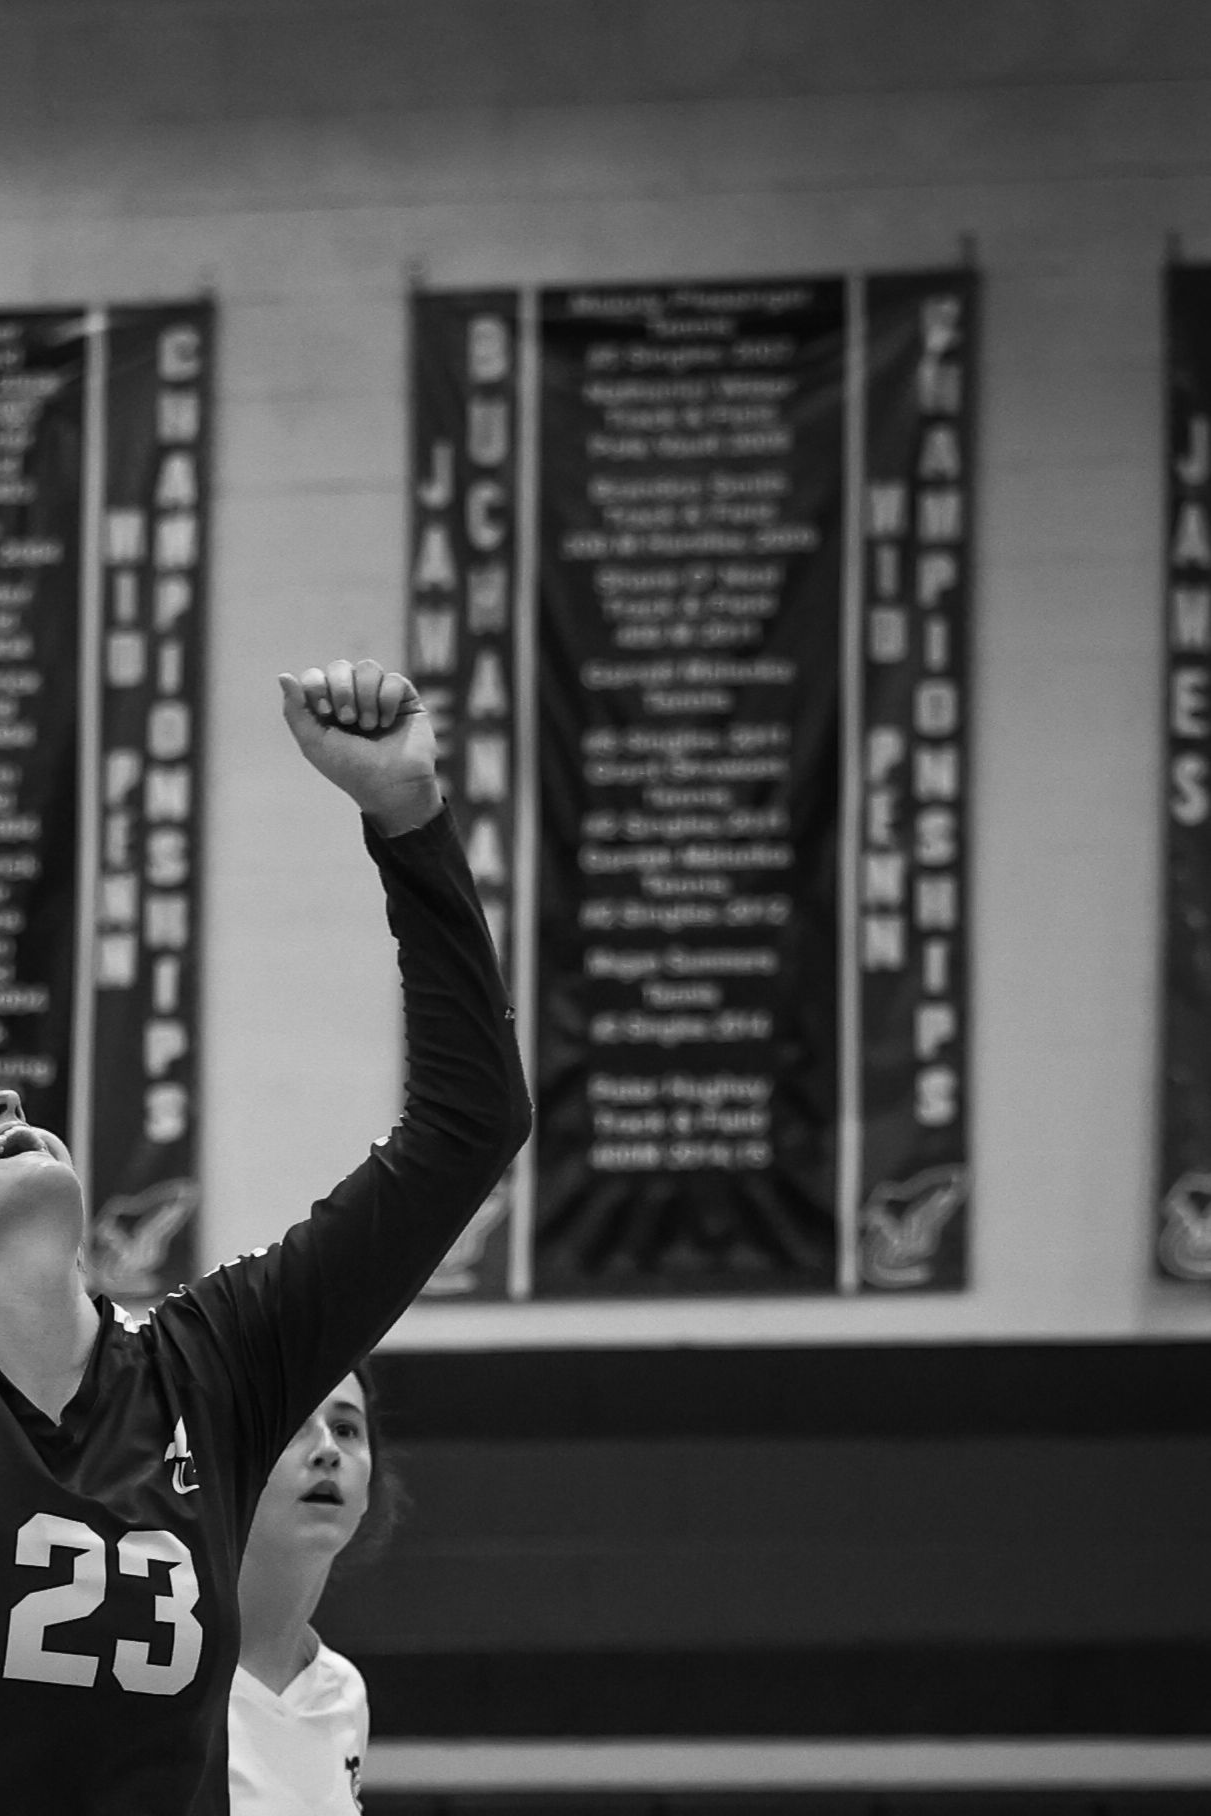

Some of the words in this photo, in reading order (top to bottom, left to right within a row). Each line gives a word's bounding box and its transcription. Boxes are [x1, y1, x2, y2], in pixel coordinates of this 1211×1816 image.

[465, 317, 509, 965] BUCHANA
[1170, 413, 1209, 827] JAMES
[2, 1512, 203, 1696] 23
